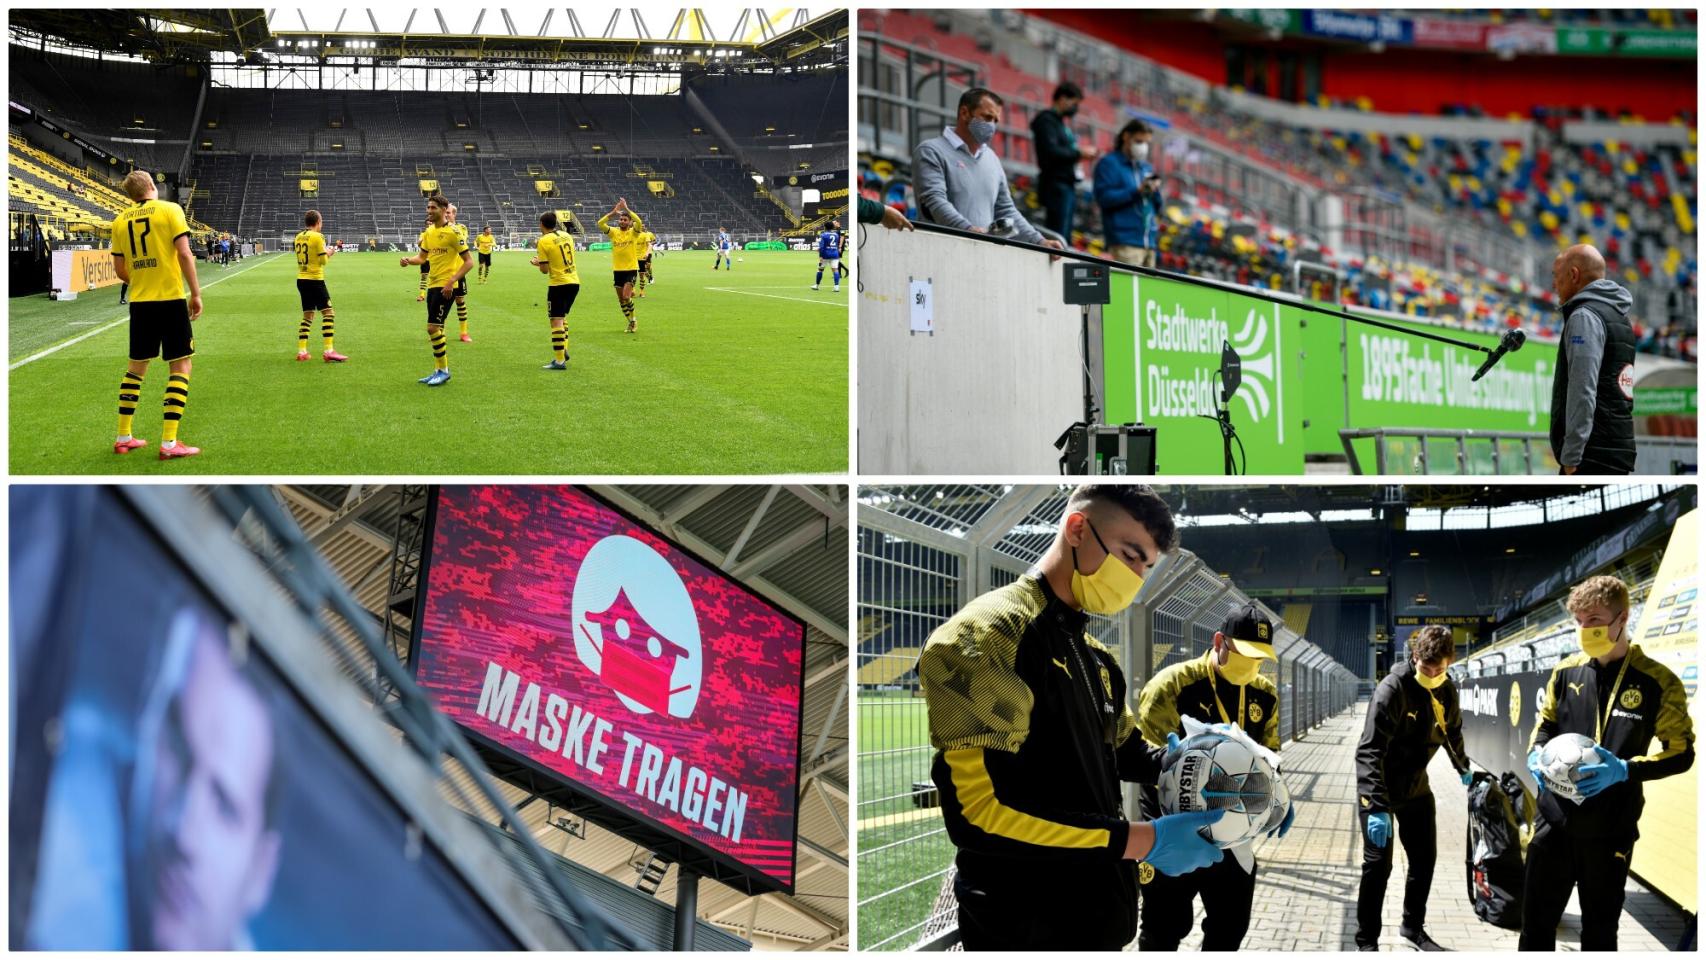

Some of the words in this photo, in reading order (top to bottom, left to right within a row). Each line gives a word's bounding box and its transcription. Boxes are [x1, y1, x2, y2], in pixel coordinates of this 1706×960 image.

[127, 217, 151, 259] 17
[829, 235, 836, 247] 2
[296, 243, 309, 265] 23
[559, 242, 573, 266] 13
[439, 304, 444, 316] 5
[915, 289, 926, 309] sky
[1146, 299, 1228, 354] Stadtwerke
[1360, 333, 1443, 406] 1895fache
[1398, 616, 1419, 625] REWE
[1480, 688, 1499, 717] PARK
[1623, 690, 1640, 704] BVB
[476, 661, 613, 775] MASKE
[617, 731, 749, 844] TRAGEN
[1179, 755, 1198, 812] RBYSTAR
